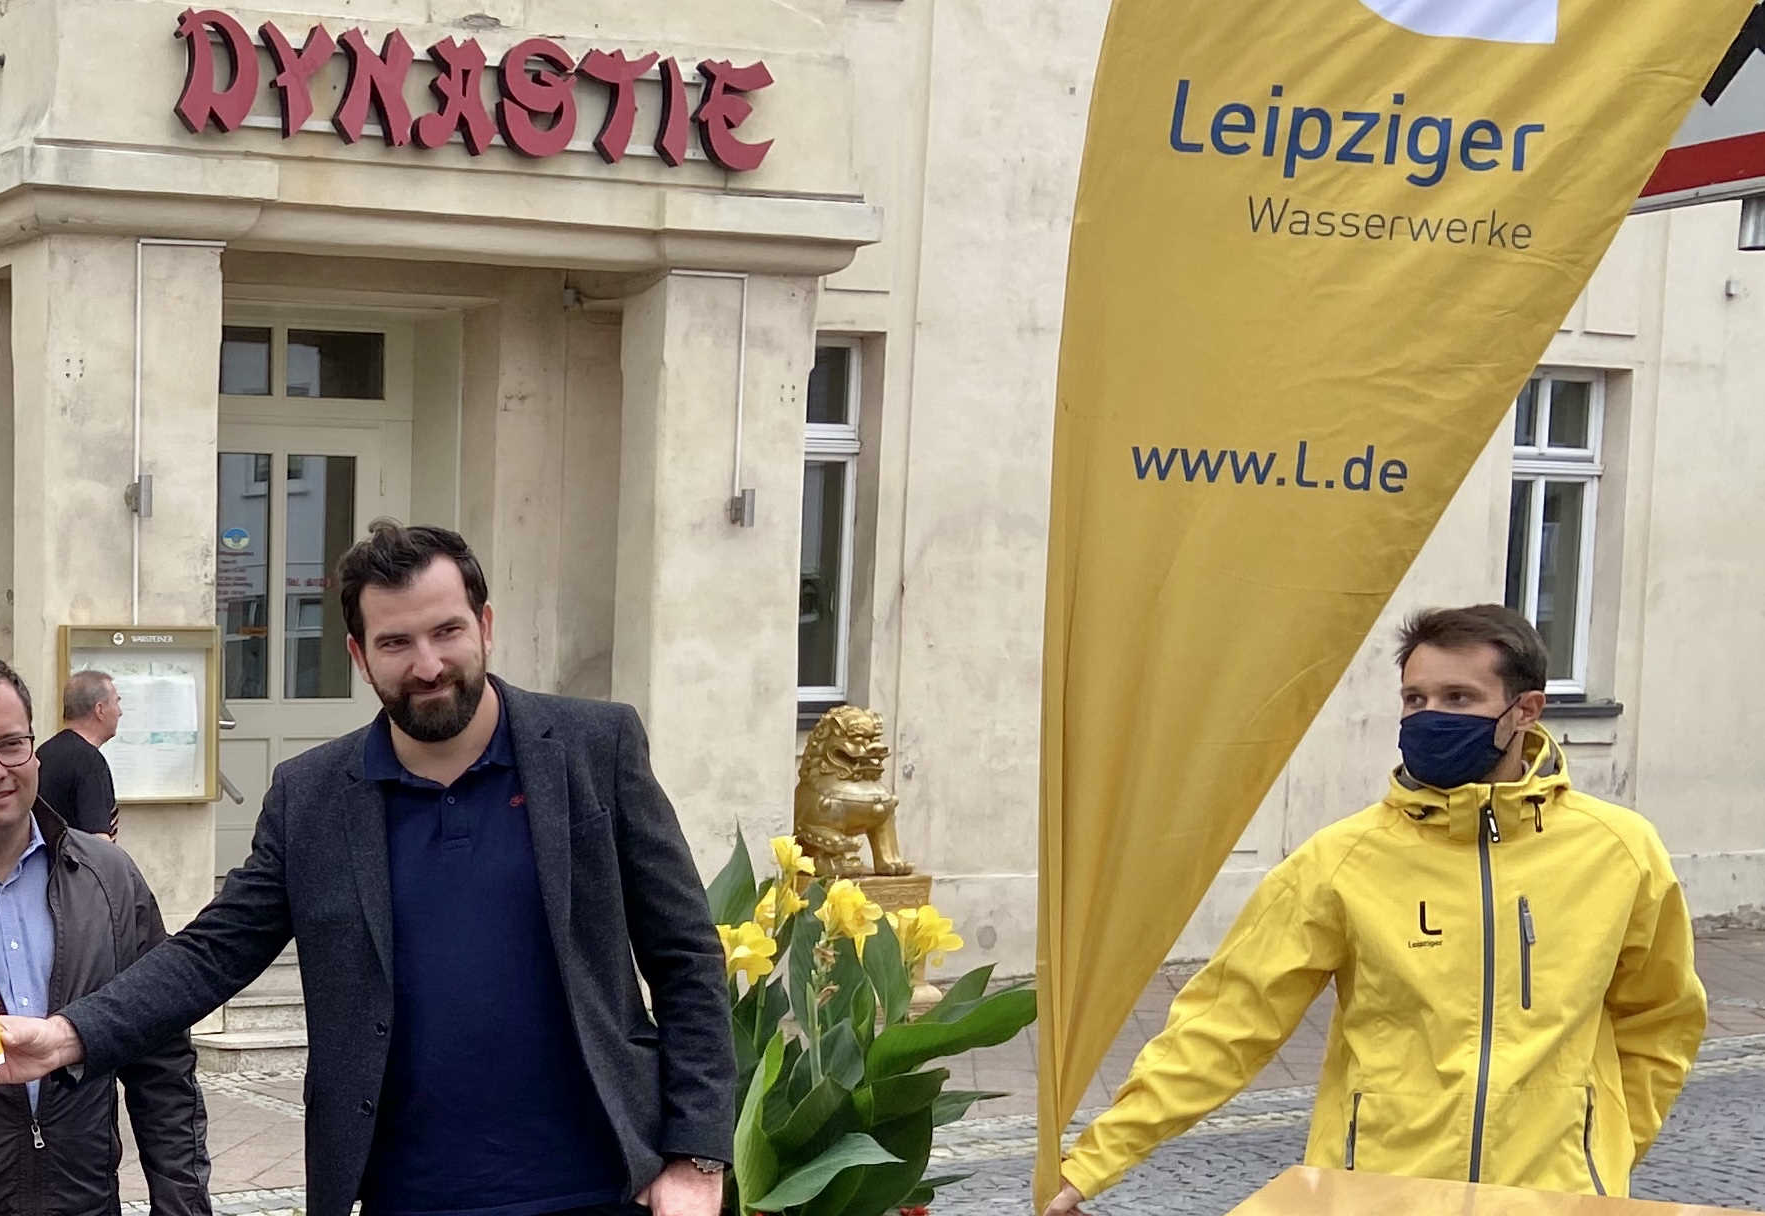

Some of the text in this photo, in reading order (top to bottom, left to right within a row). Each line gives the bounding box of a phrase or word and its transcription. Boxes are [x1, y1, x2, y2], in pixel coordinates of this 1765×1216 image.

[173, 7, 776, 172] DYNASTIE
[1168, 79, 1546, 188] Leipziger
[1246, 195, 1533, 250] Wasserwerke
[1131, 440, 1409, 494] www.L.de
